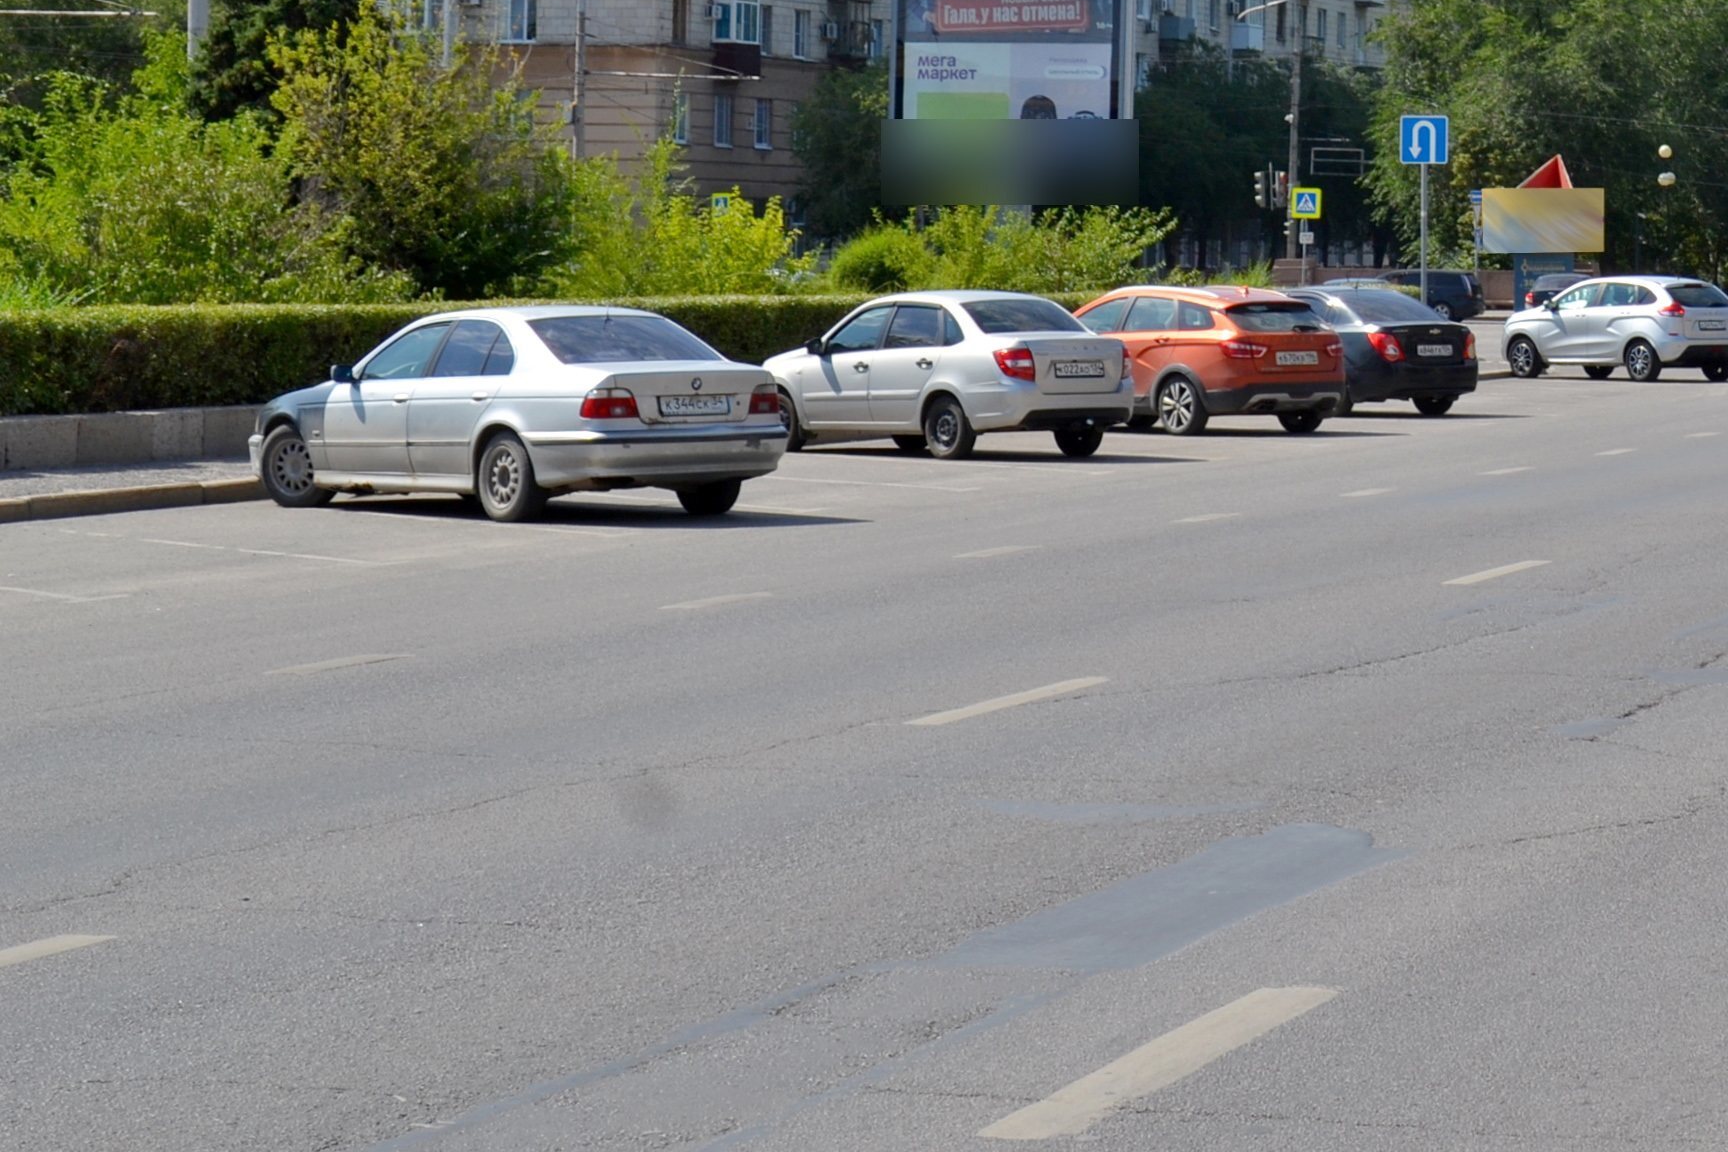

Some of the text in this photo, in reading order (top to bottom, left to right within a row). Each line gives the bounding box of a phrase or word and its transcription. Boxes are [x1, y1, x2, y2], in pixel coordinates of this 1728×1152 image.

[992, 5, 1019, 23] нас
[1022, 1, 1081, 23] отмена!
[917, 55, 957, 67] мега
[917, 68, 977, 82] маркет
